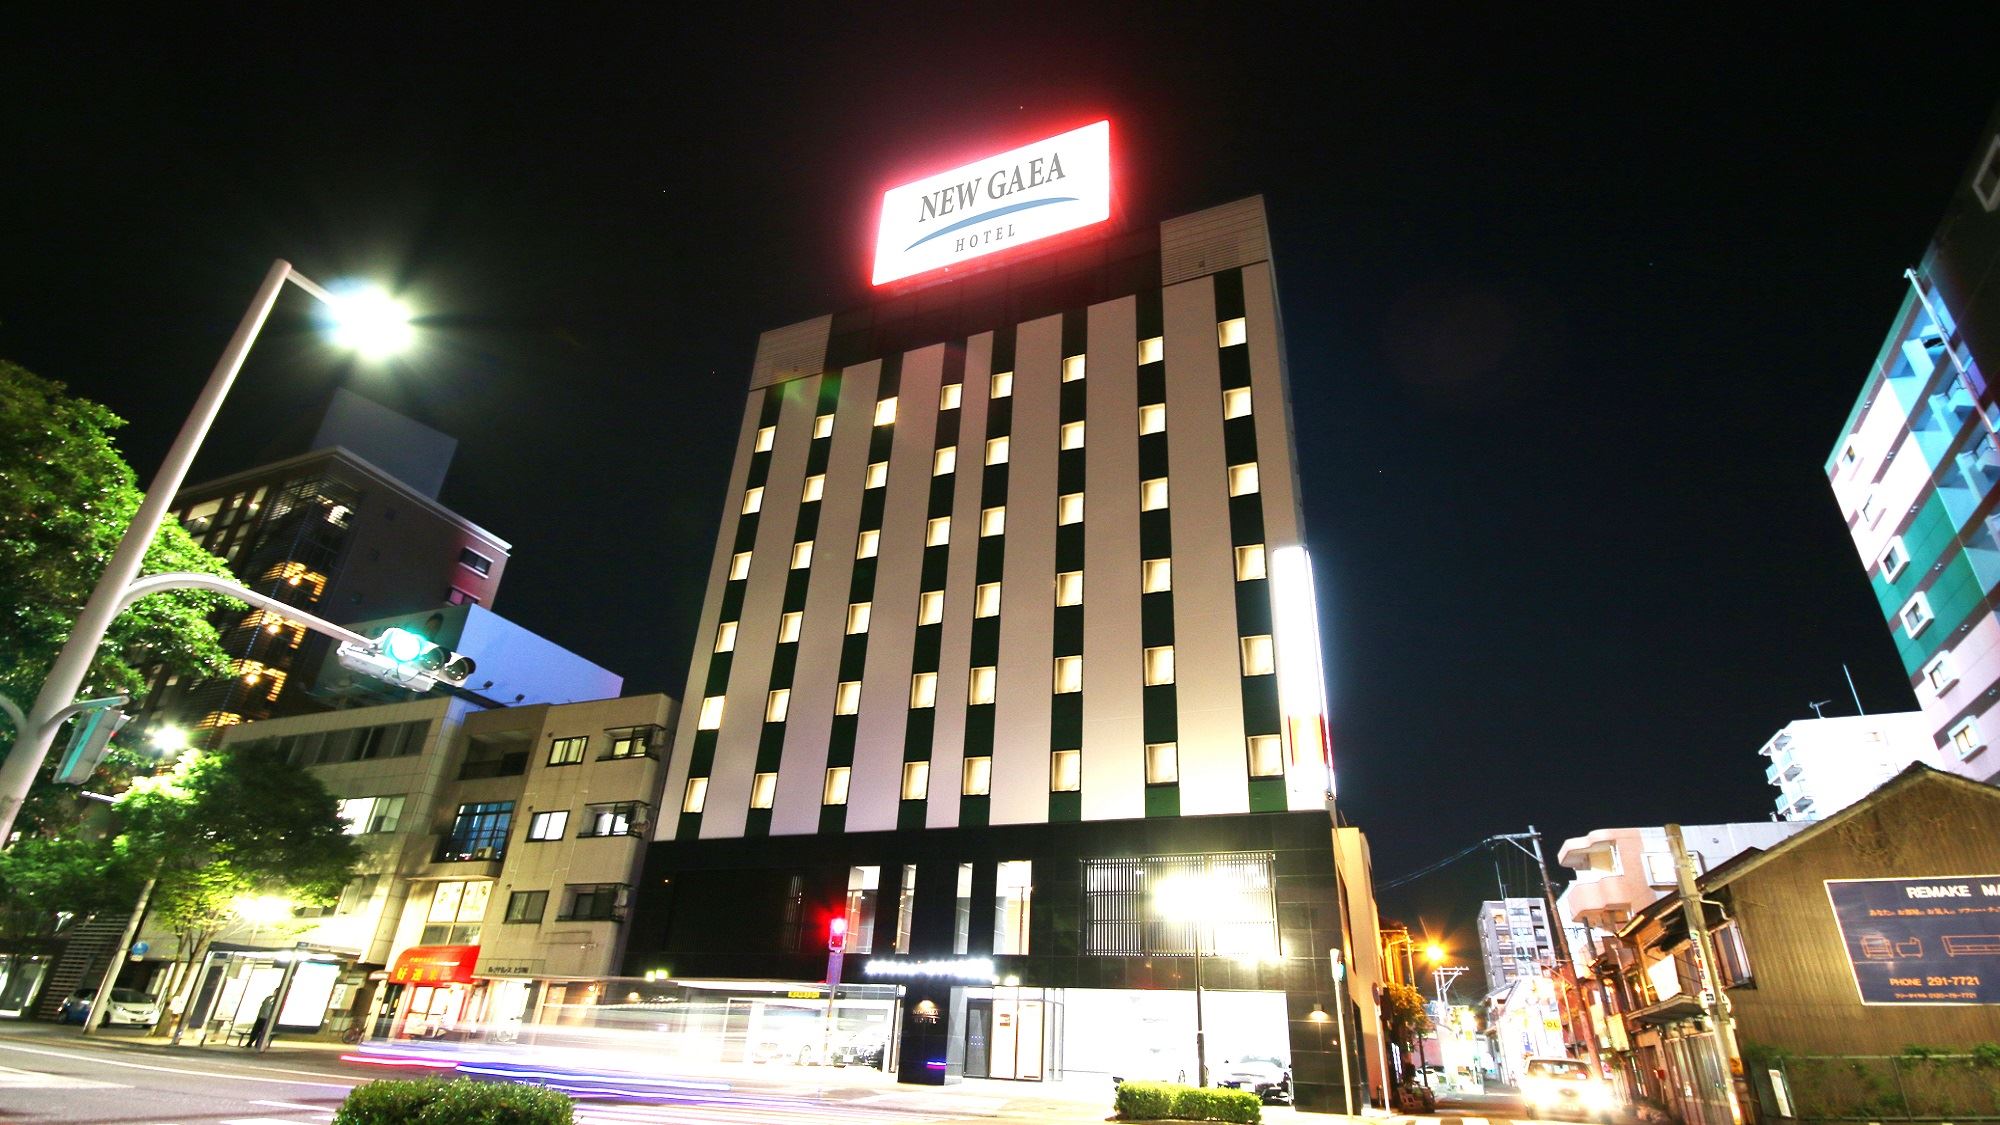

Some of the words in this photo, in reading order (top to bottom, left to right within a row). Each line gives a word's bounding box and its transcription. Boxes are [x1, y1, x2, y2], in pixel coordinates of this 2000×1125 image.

[918, 177, 982, 223] NEW
[987, 152, 1067, 200] GAEA
[955, 224, 1016, 252] HOTEL
[1905, 885, 1972, 898] REMAKE
[1889, 977, 1922, 986] PHONE
[1926, 976, 1980, 986] 291-7721
